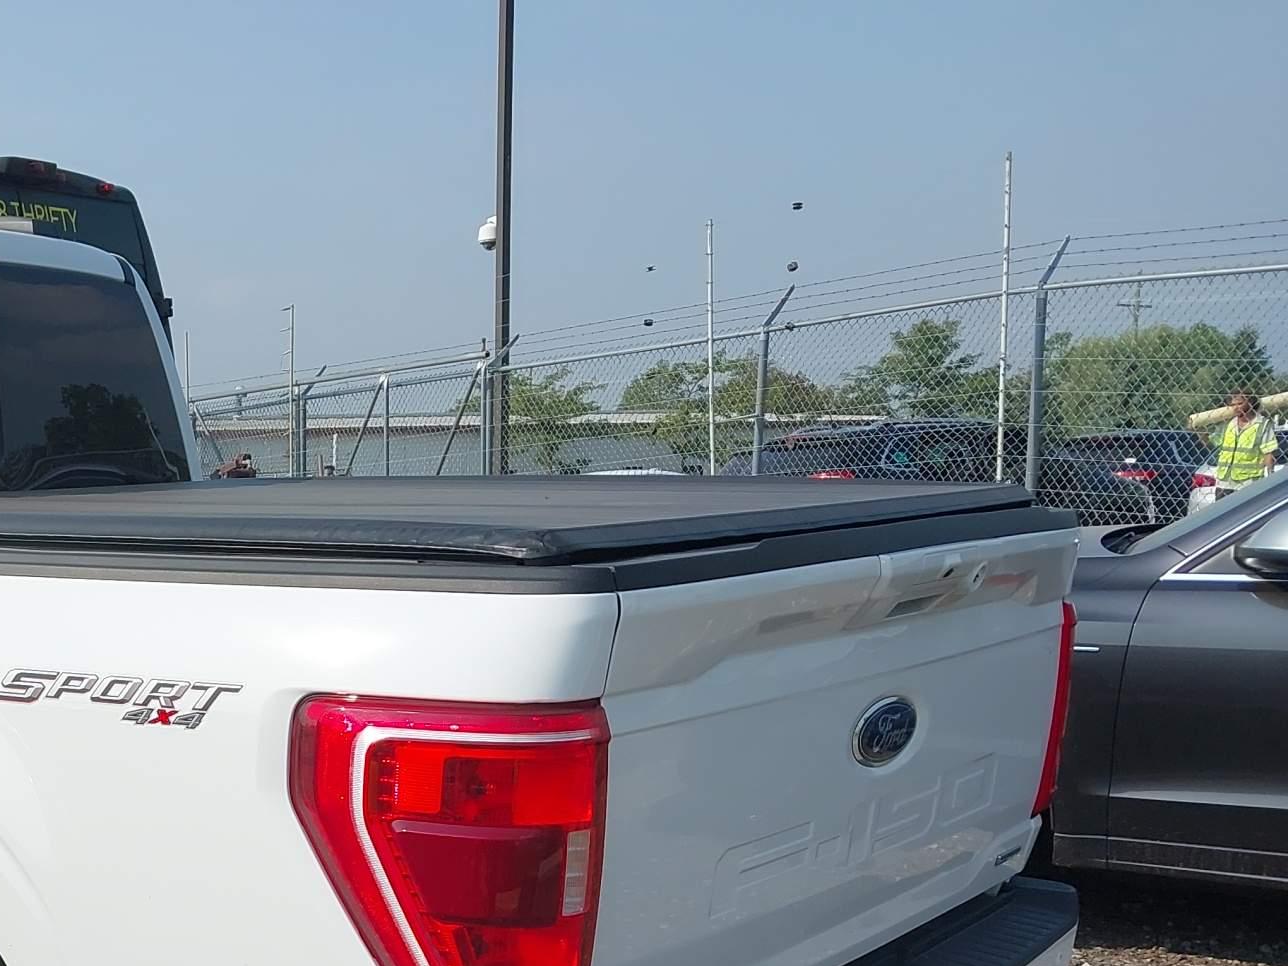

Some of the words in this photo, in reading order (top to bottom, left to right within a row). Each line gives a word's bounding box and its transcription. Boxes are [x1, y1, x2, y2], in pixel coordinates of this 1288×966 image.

[10, 201, 77, 233] THRIFTY
[871, 711, 911, 754] Ford
[708, 752, 999, 920] F-150
